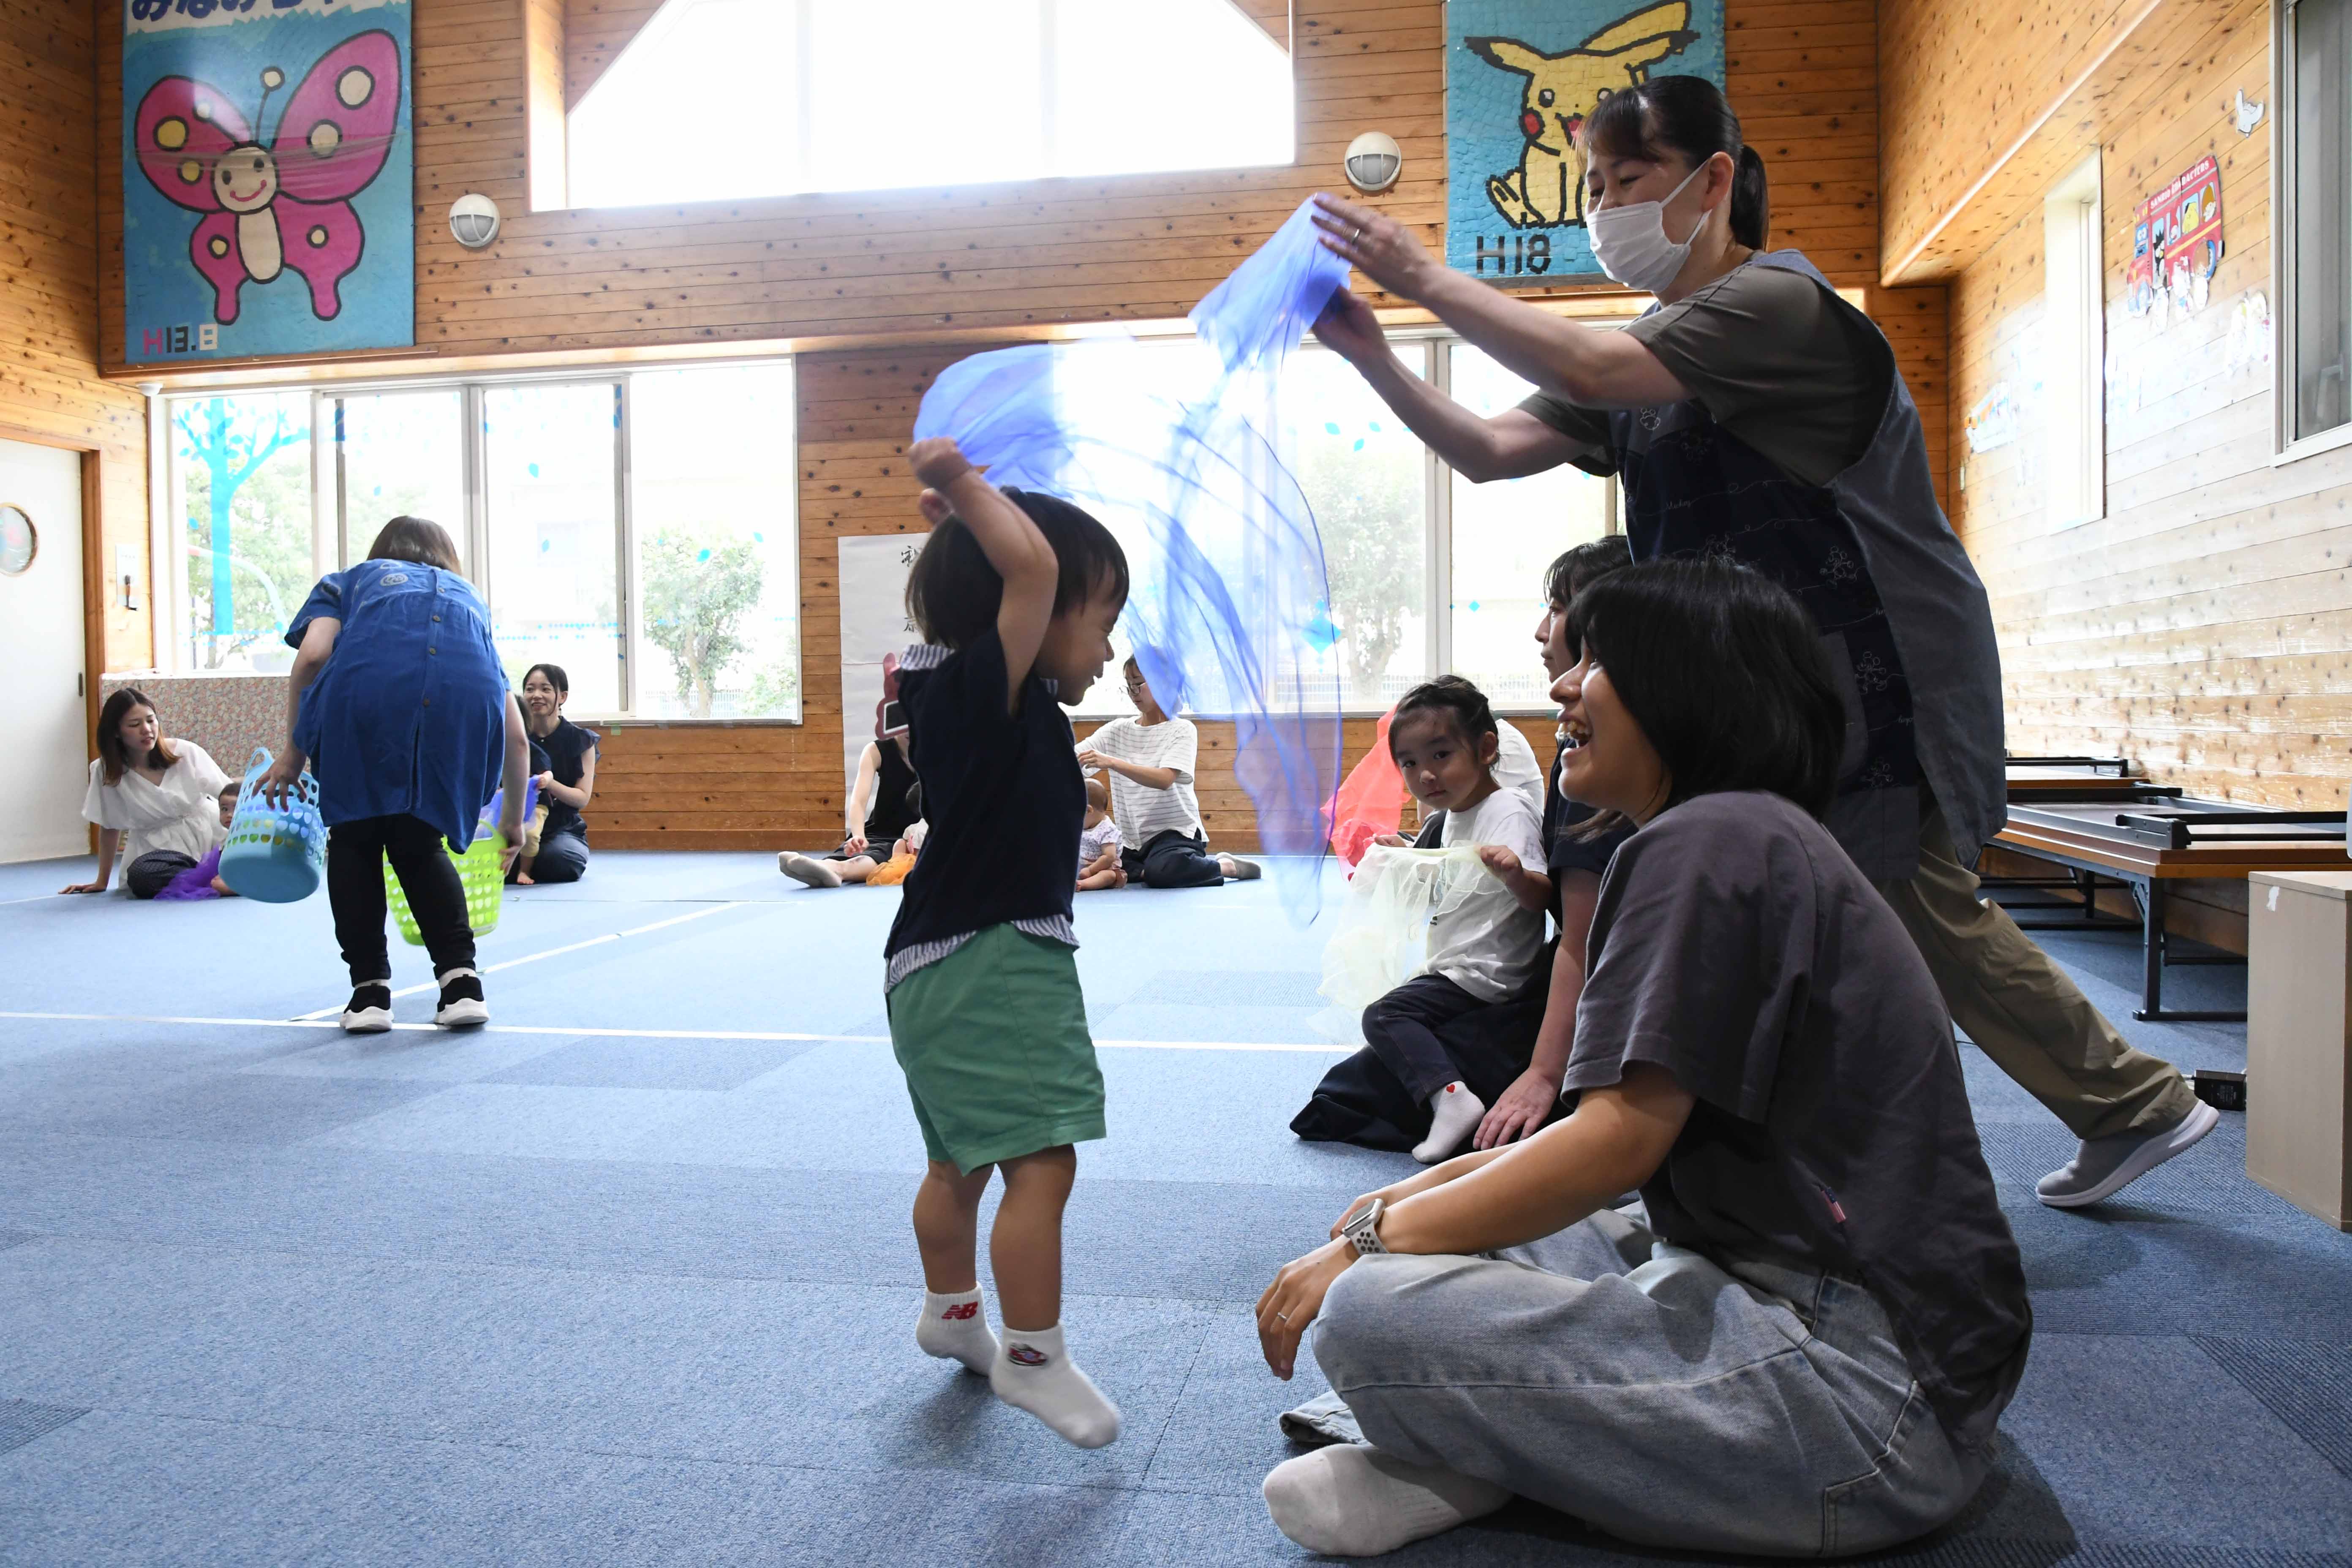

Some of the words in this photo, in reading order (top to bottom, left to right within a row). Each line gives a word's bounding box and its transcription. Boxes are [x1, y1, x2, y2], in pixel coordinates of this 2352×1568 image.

[1476, 234, 1551, 275] H18
[143, 323, 218, 355] H13.8
[942, 1301, 978, 1320] NB
